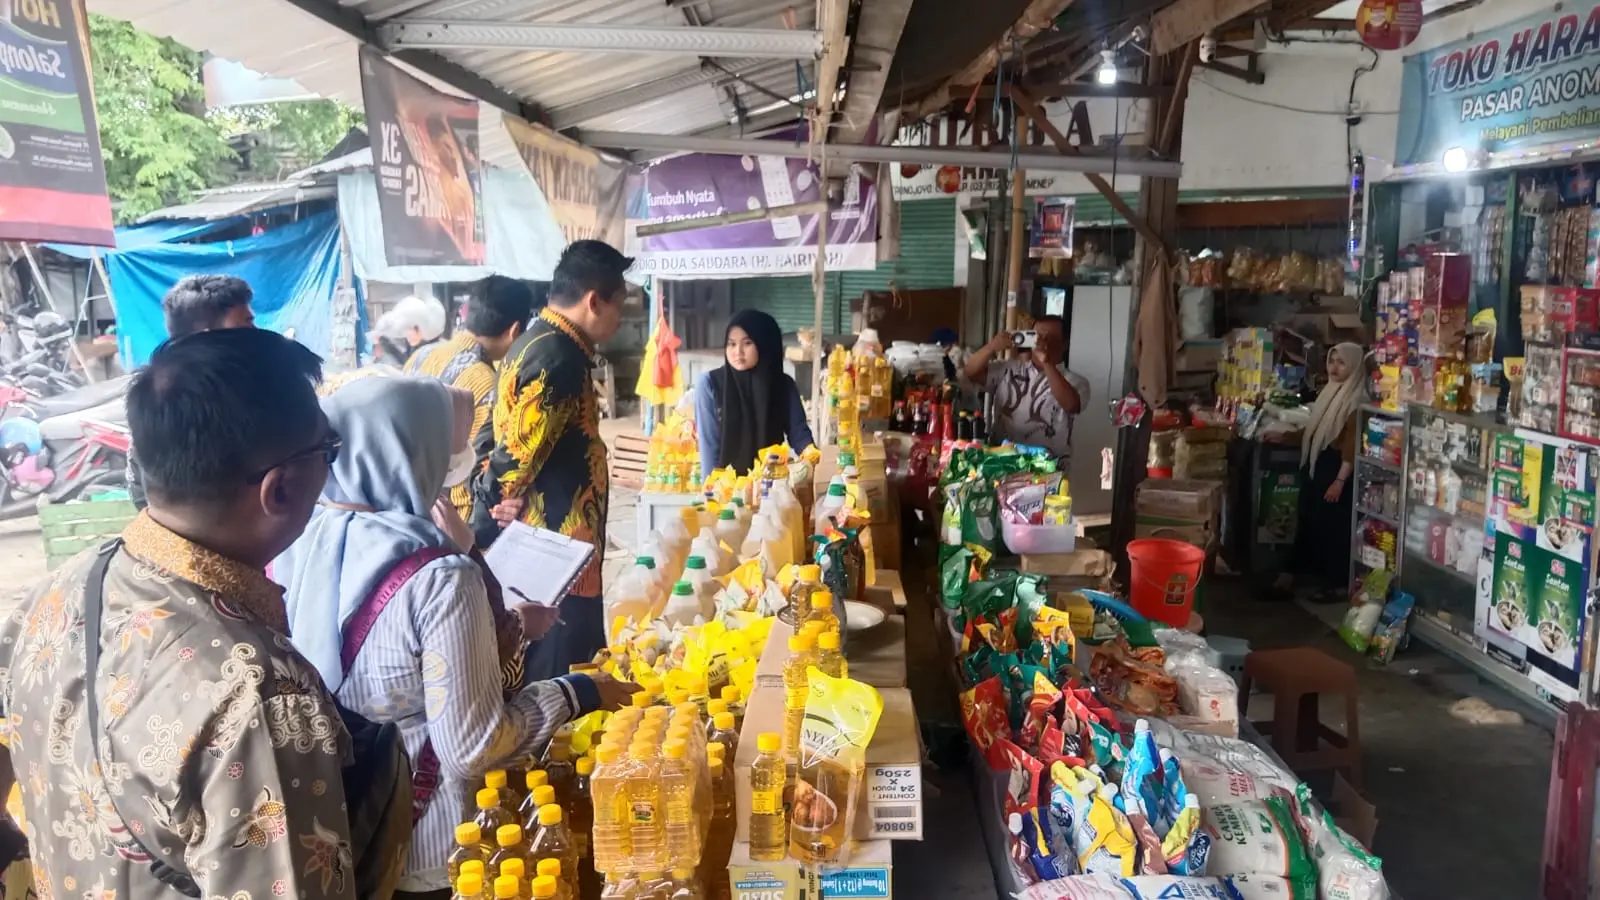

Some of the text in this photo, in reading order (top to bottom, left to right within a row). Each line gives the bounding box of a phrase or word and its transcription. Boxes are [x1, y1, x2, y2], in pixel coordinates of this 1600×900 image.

[1429, 40, 1501, 96] TOKO
[1461, 85, 1522, 122] PASAR
[1480, 125, 1529, 143] Melayani
[685, 189, 715, 207] Nyata
[661, 257, 687, 270] DUA
[692, 254, 745, 270] SAUDARA
[1545, 573, 1570, 592] Santan
[875, 768, 912, 778] 250g
[900, 784, 915, 792] 24
[878, 882, 886, 892] 10
